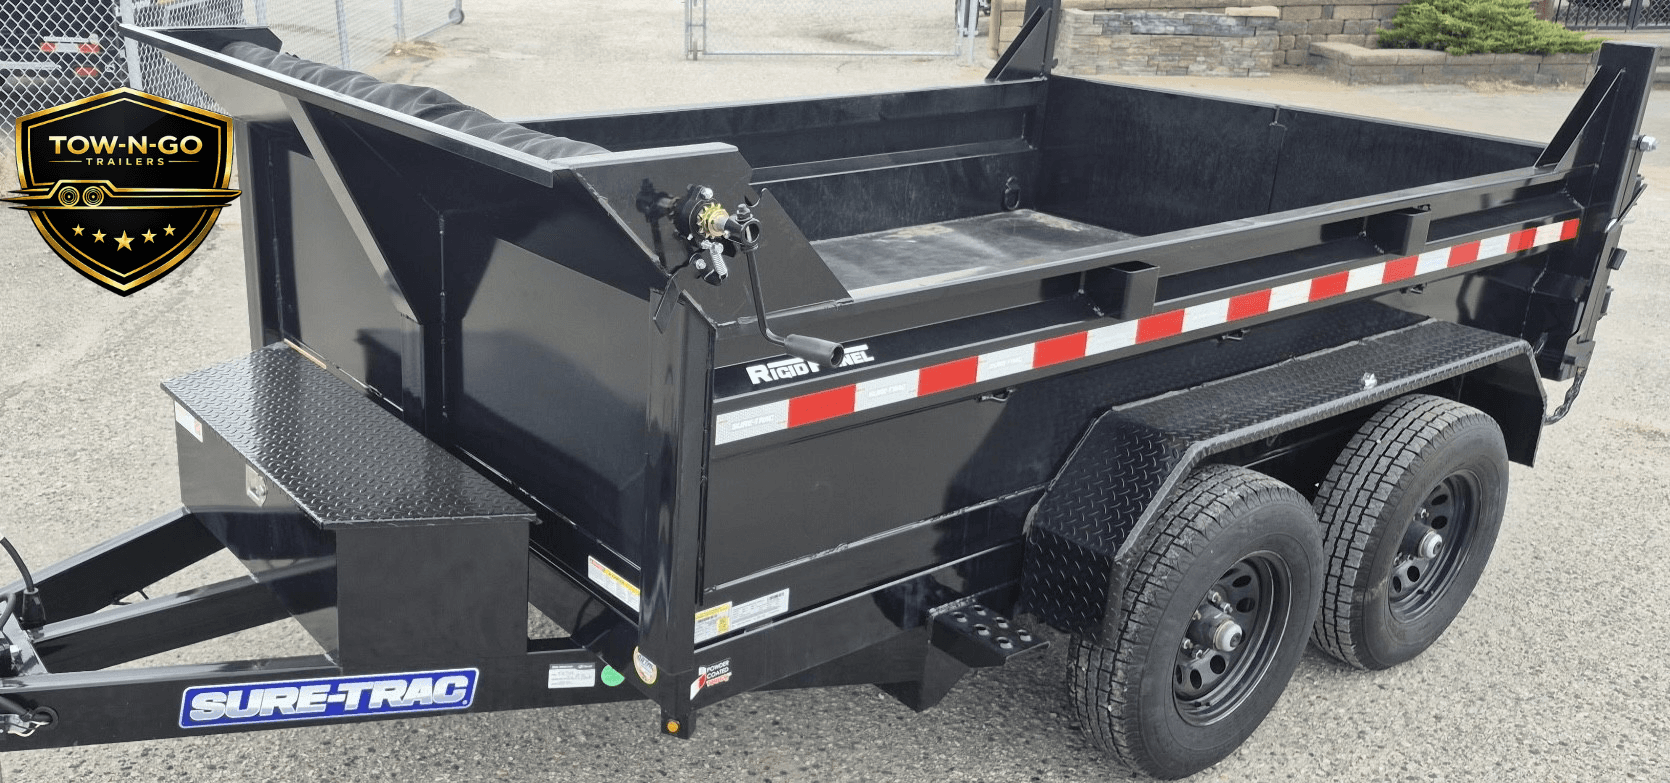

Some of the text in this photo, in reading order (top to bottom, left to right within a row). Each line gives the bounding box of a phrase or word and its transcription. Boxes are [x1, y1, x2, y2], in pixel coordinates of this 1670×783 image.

[746, 344, 874, 385] RIGID PNEL
[706, 659, 730, 673] POWDER
[706, 666, 730, 679] COATED
[189, 675, 470, 721] SURE-TRAC
